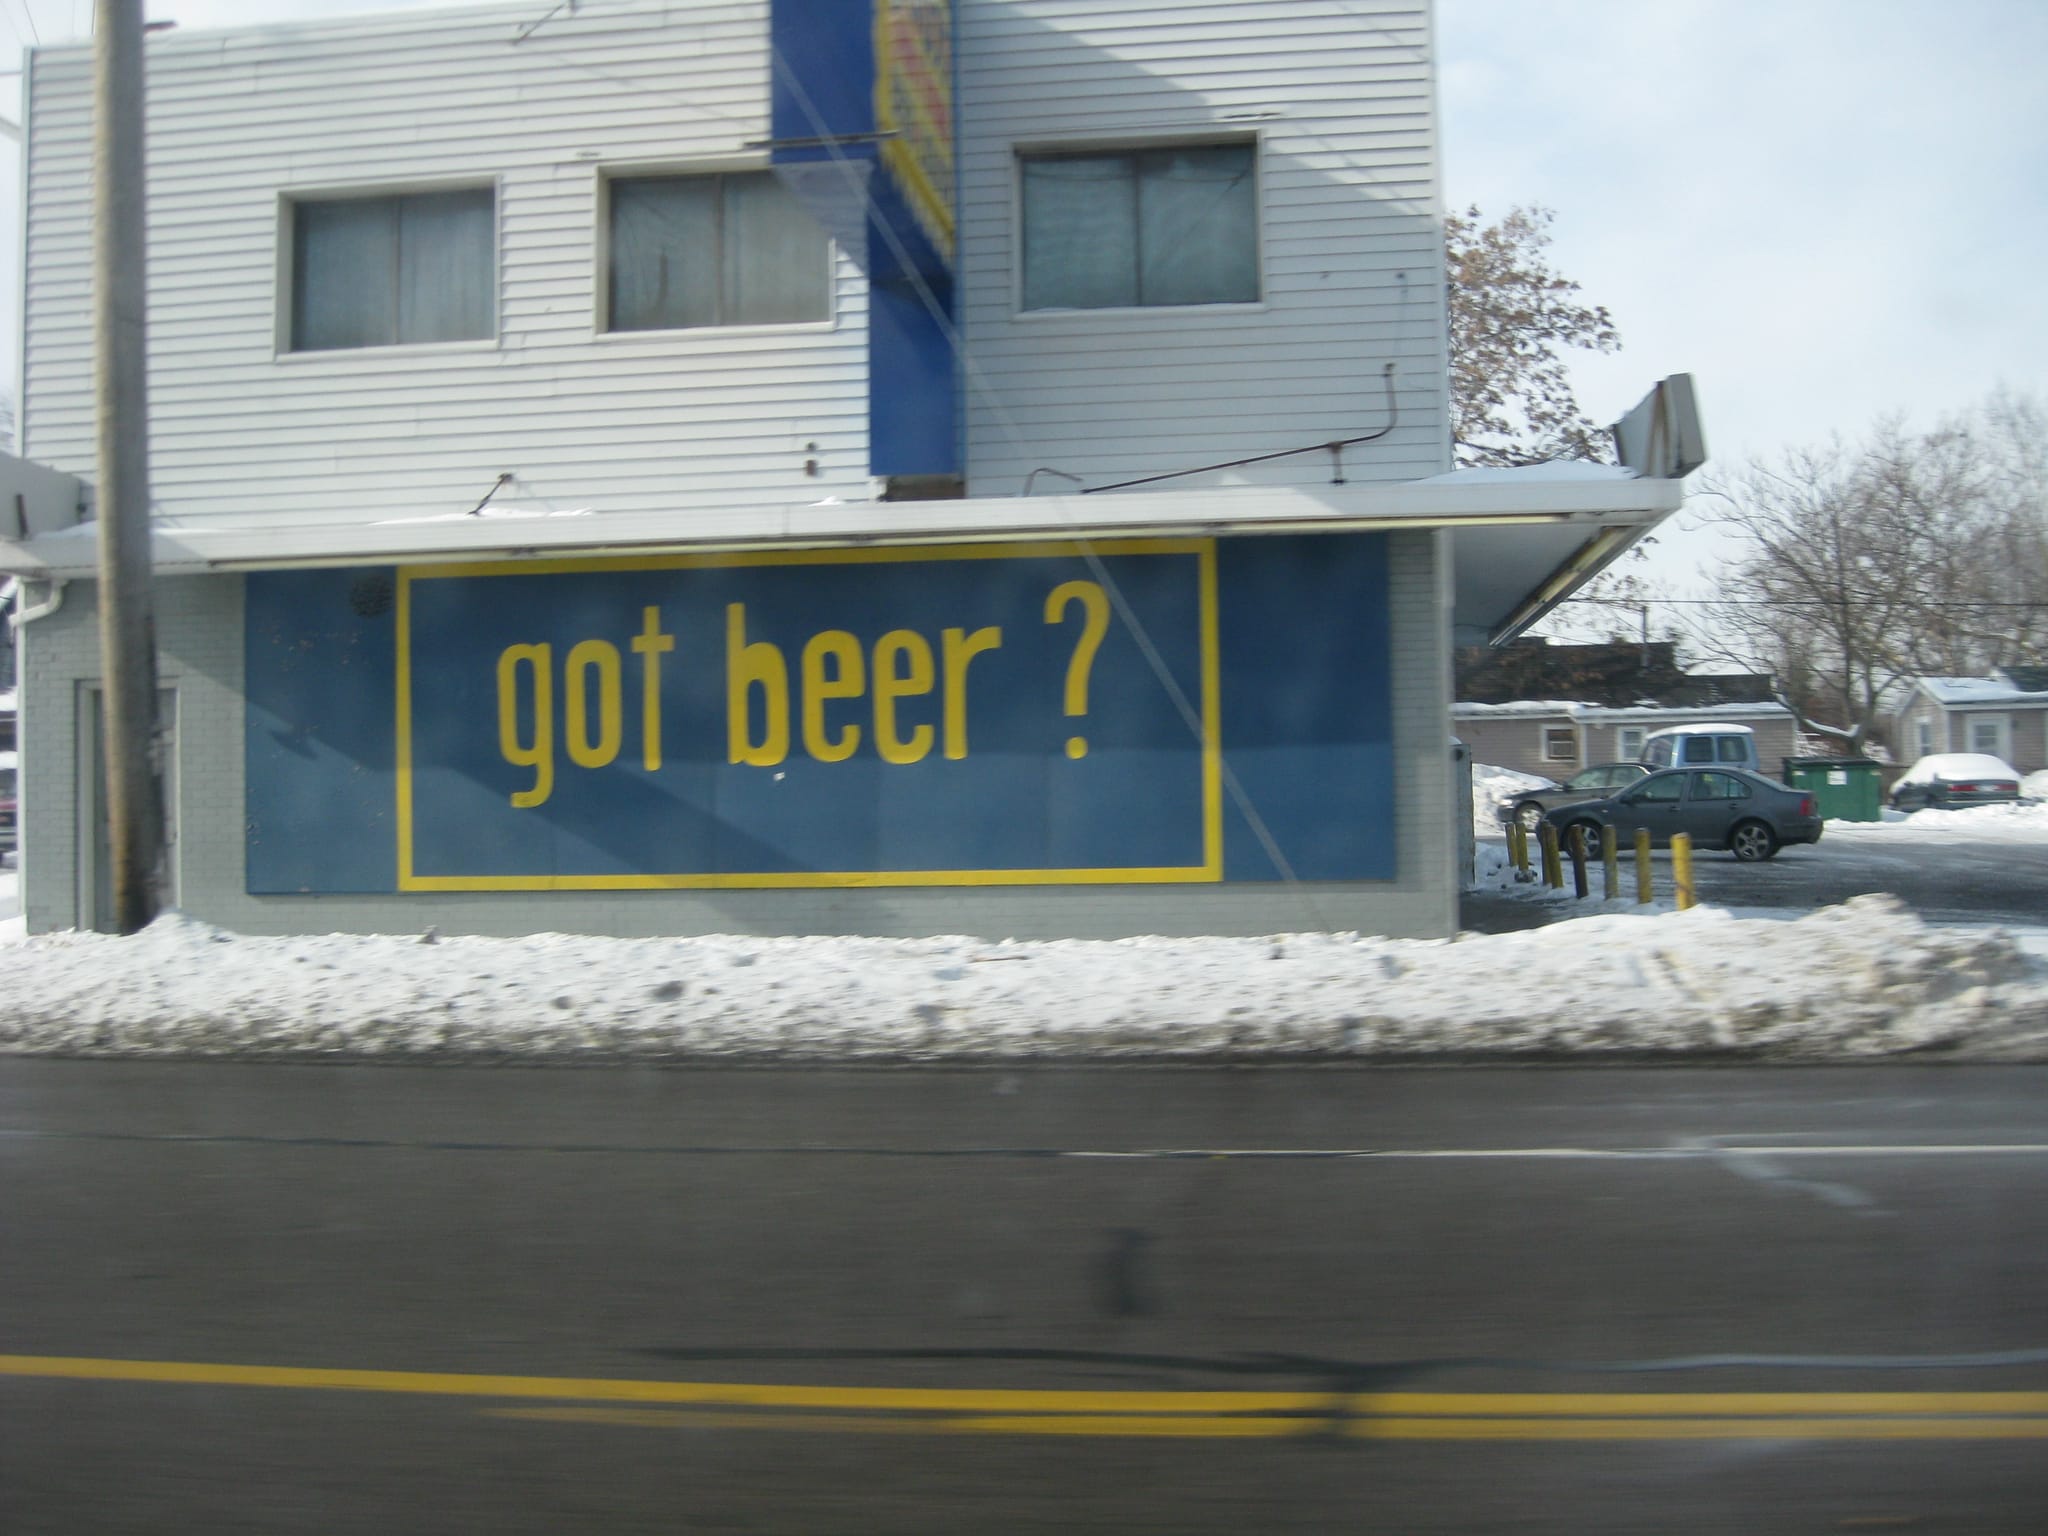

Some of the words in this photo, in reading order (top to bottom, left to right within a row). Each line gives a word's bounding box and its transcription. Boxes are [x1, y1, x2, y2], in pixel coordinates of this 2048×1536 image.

[496, 605, 674, 809] got
[727, 602, 1002, 767] beer
[1044, 580, 1110, 760] ?
